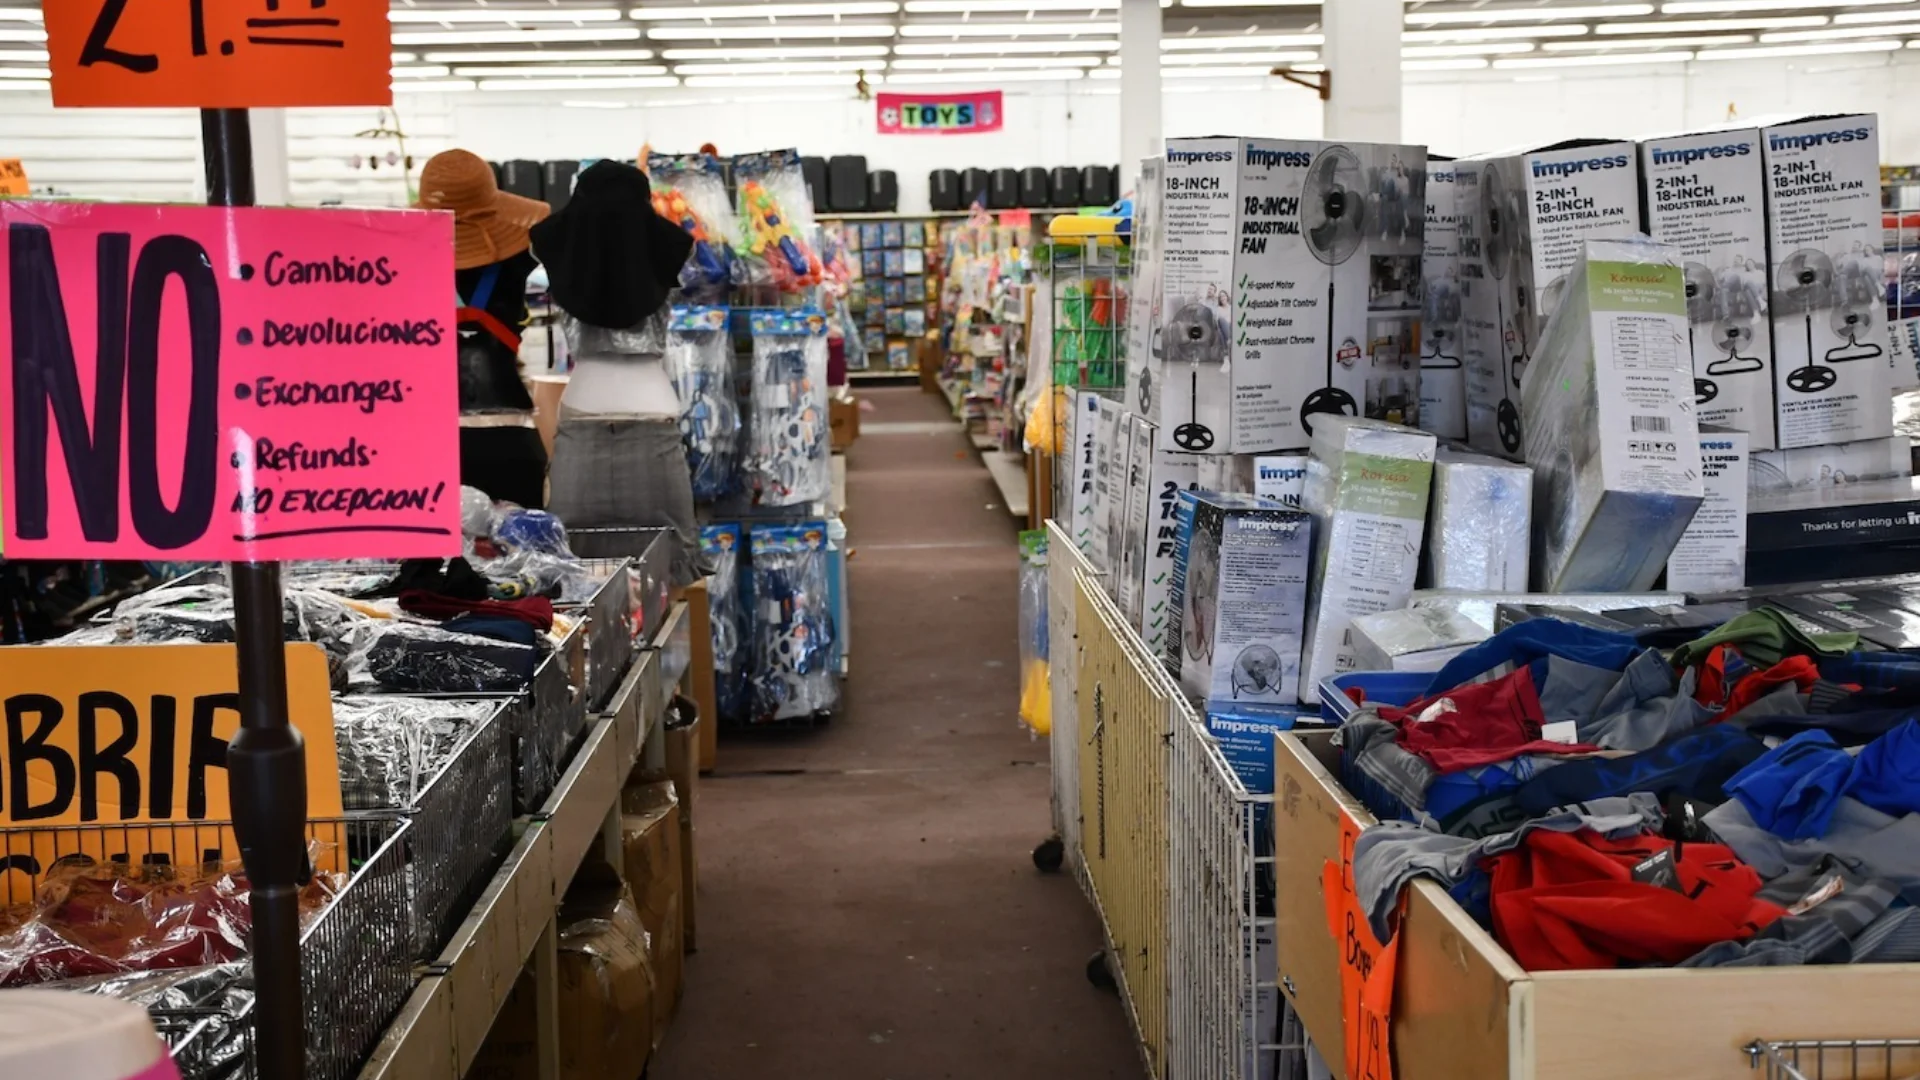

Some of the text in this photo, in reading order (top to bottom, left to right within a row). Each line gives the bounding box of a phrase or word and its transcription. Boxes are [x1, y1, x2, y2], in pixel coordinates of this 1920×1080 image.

[904, 106, 973, 125] TOYS
[1770, 127, 1869, 151] impress
[1167, 148, 1232, 165] impress
[1247, 144, 1310, 170] impress
[1652, 142, 1750, 165] impress
[1531, 155, 1627, 178] impress
[1773, 160, 1816, 175] 2-IN-1
[1166, 177, 1219, 190] 18-INCH
[1656, 174, 1698, 189] 2-IN-1
[1774, 171, 1832, 189] 18-INCH
[1166, 192, 1229, 200] INDUSTRIAL FAN
[1535, 187, 1578, 202] 2-IN-1
[1656, 185, 1714, 202] 18-INCH
[1774, 180, 1863, 199] INDUSTRIAL FAN
[1244, 196, 1299, 216] 18-INCH
[1536, 198, 1594, 214] 18-INCH
[1657, 195, 1745, 212] INDUSTRIAL FAN
[1537, 207, 1624, 224] INDUSTRIAL FAN
[1242, 221, 1300, 235] INDUSTRIAL
[1240, 237, 1266, 254] FAN
[1247, 280, 1295, 291] Hi-speed Motor
[1246, 298, 1279, 310] Adjustable
[1293, 298, 1318, 308] Control
[1246, 317, 1292, 329] Weighted Base
[1245, 335, 1315, 346] Rust-resistant Chrome
[8, 222, 221, 549] NO
[1260, 465, 1307, 482] impr
[280, 482, 446, 517] EXCEPCION!
[1238, 518, 1295, 531] impress
[1802, 517, 1907, 532] Thanks for letting us
[1211, 717, 1279, 734] impress
